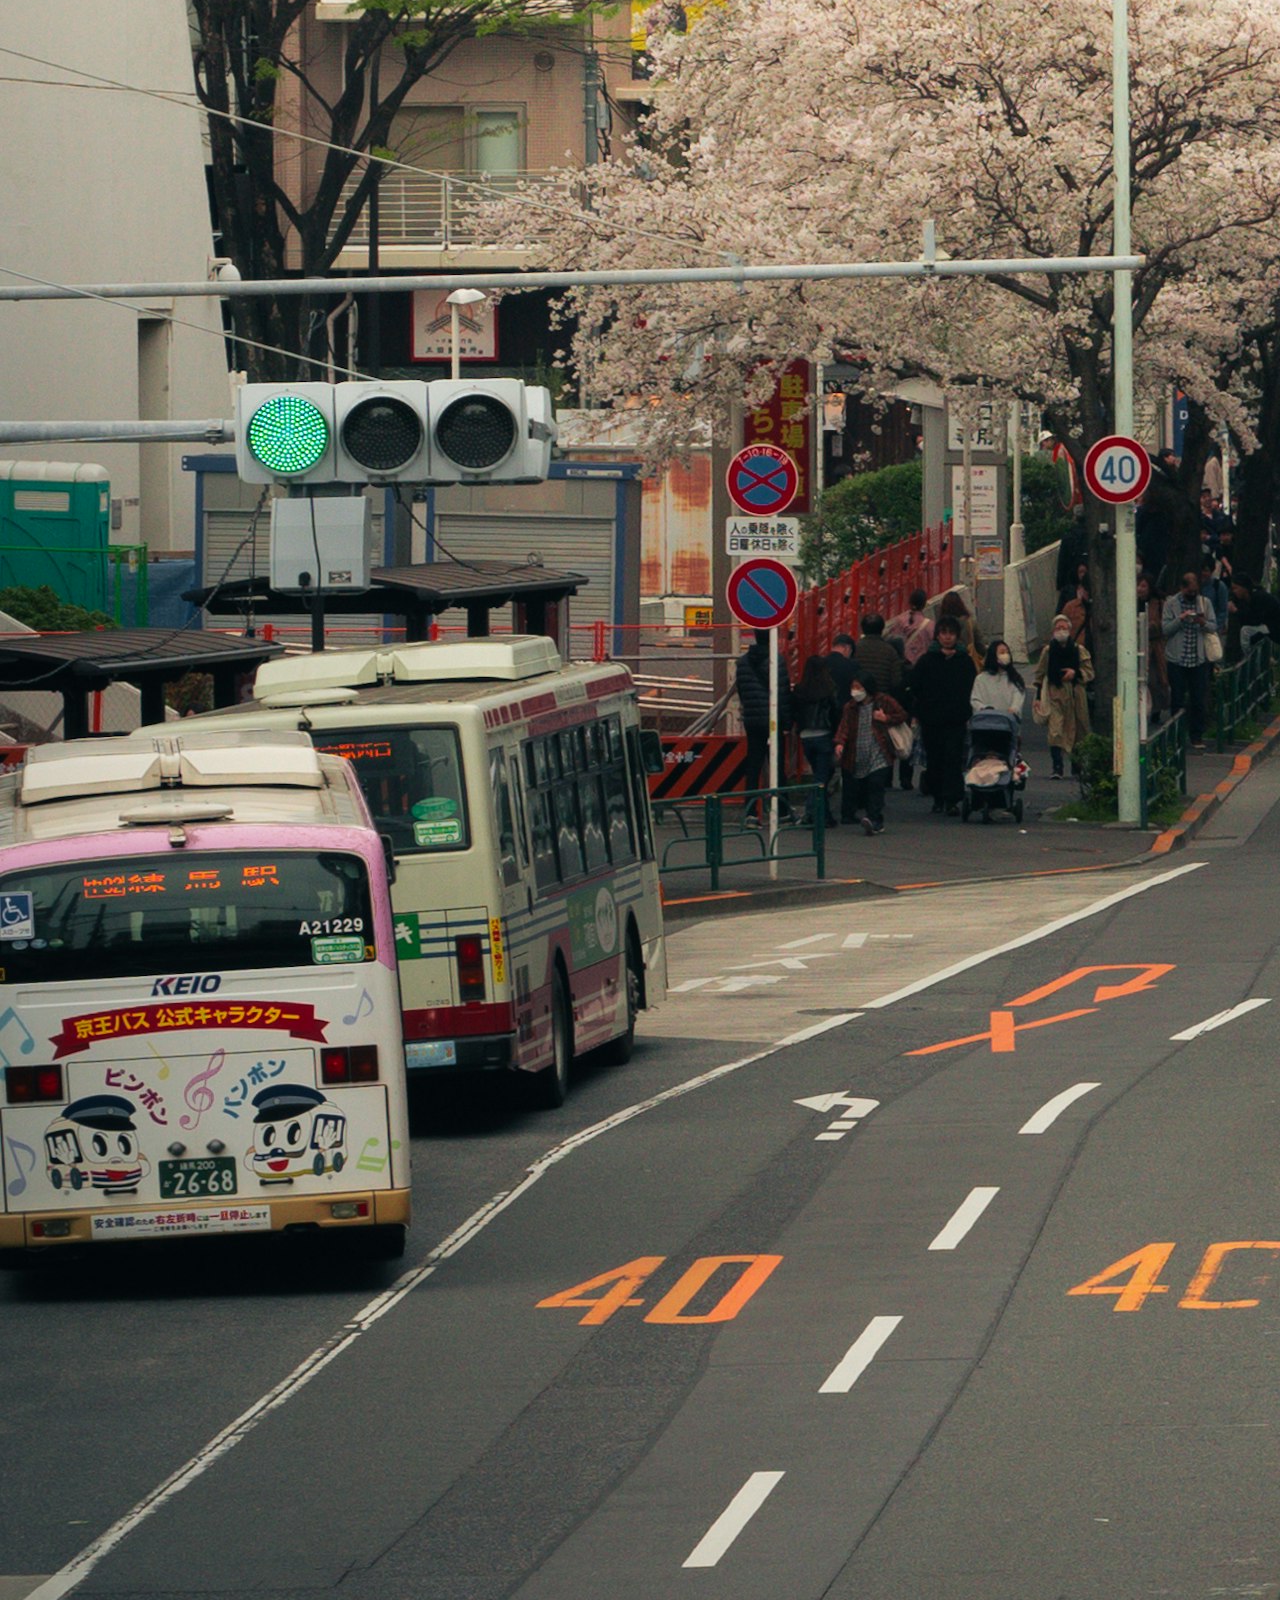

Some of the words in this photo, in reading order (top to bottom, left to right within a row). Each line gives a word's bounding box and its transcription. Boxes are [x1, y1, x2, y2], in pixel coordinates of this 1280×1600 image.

[1101, 455, 1135, 484] 40
[299, 917, 365, 936] A21229
[151, 974, 222, 997] KEIO
[73, 1011, 151, 1040] 京王バス
[155, 1005, 301, 1028] 公式キャラクター
[105, 1067, 168, 1126] ピンポン
[222, 1059, 287, 1120] パンポン
[173, 1168, 235, 1196] 26-68
[534, 1254, 784, 1326] 40
